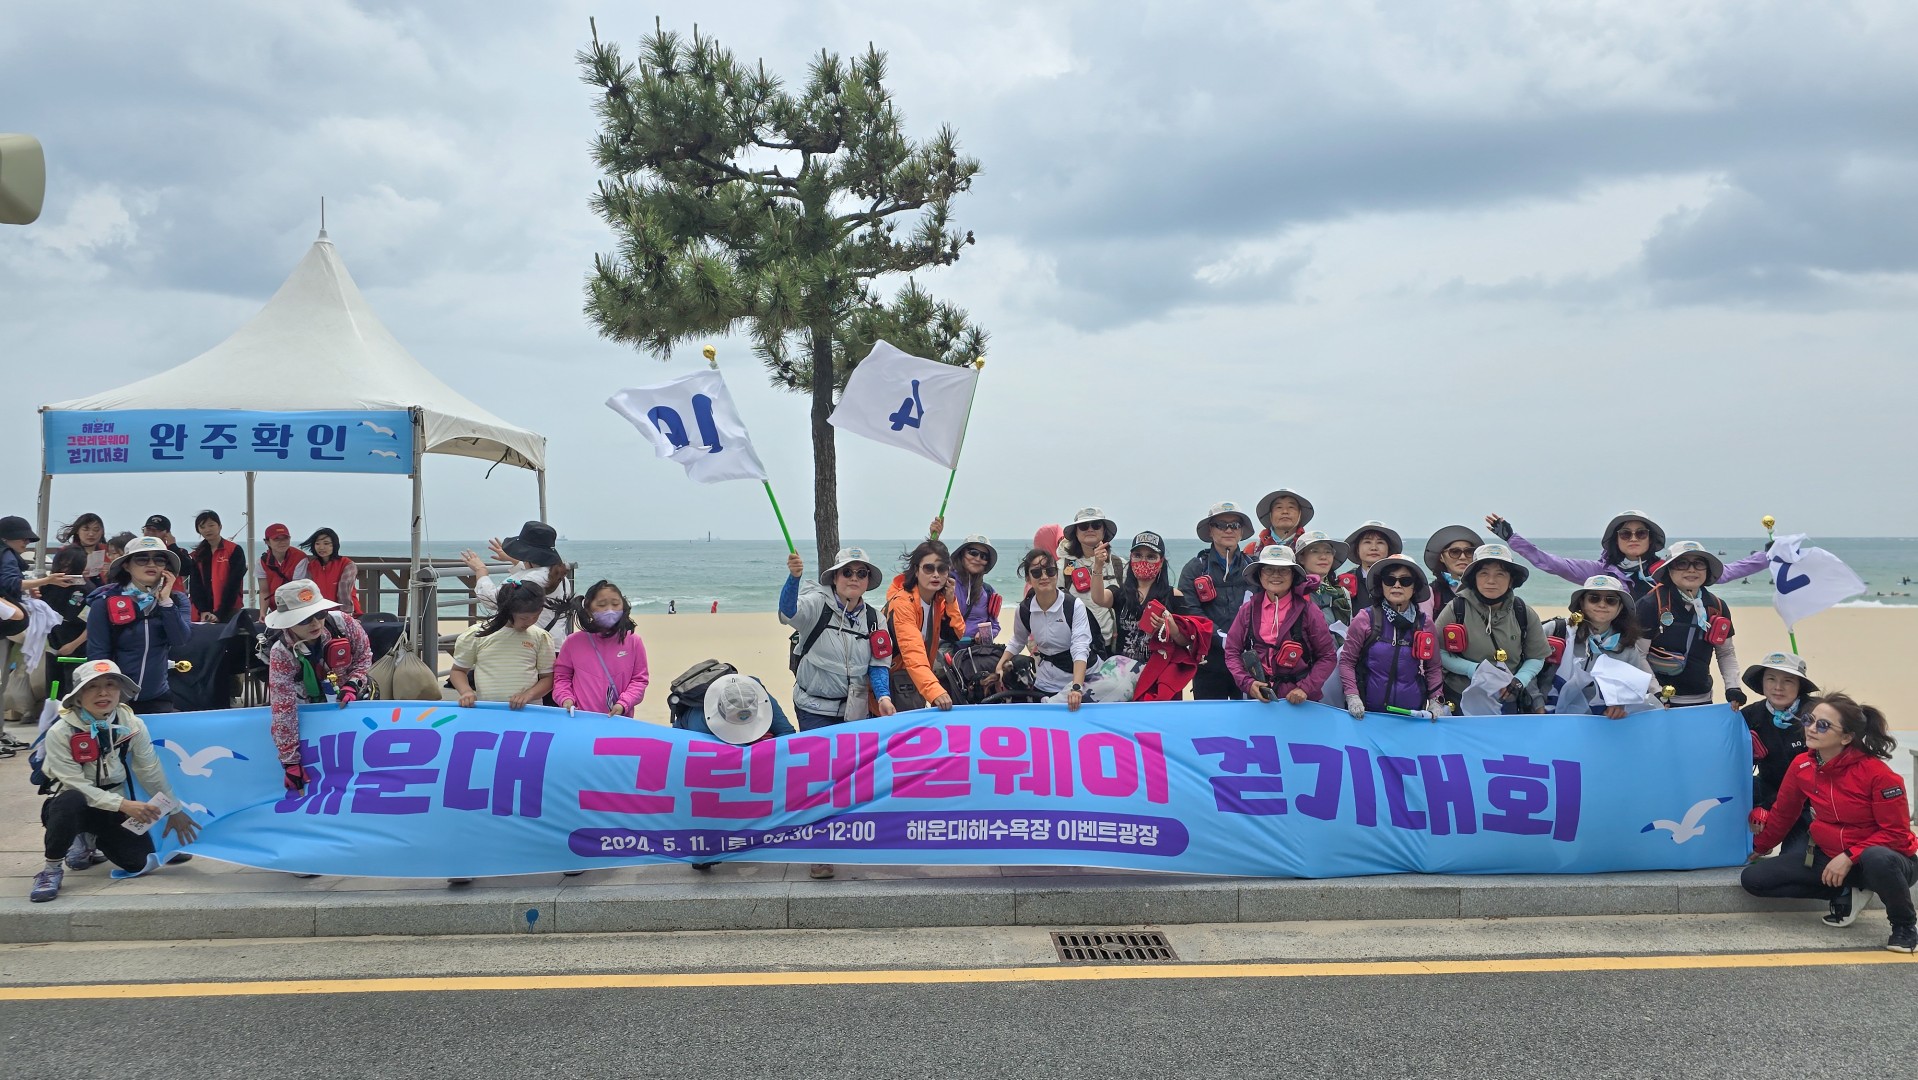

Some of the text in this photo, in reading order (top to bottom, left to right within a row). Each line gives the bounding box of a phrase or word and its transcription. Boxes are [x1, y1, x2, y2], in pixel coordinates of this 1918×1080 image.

[82, 422, 115, 434] 해운대
[66, 434, 130, 446] 그린레일웨이
[67, 447, 129, 464] 걷기대회
[274, 725, 1582, 842] 해운대 그린레일웨이 걷기대회
[600, 835, 655, 853] 2024.
[662, 837, 682, 852] 5.
[689, 835, 711, 851] 11.
[907, 819, 1052, 841] 해운대해수욕장
[1057, 819, 1159, 847] 이벤트광장
